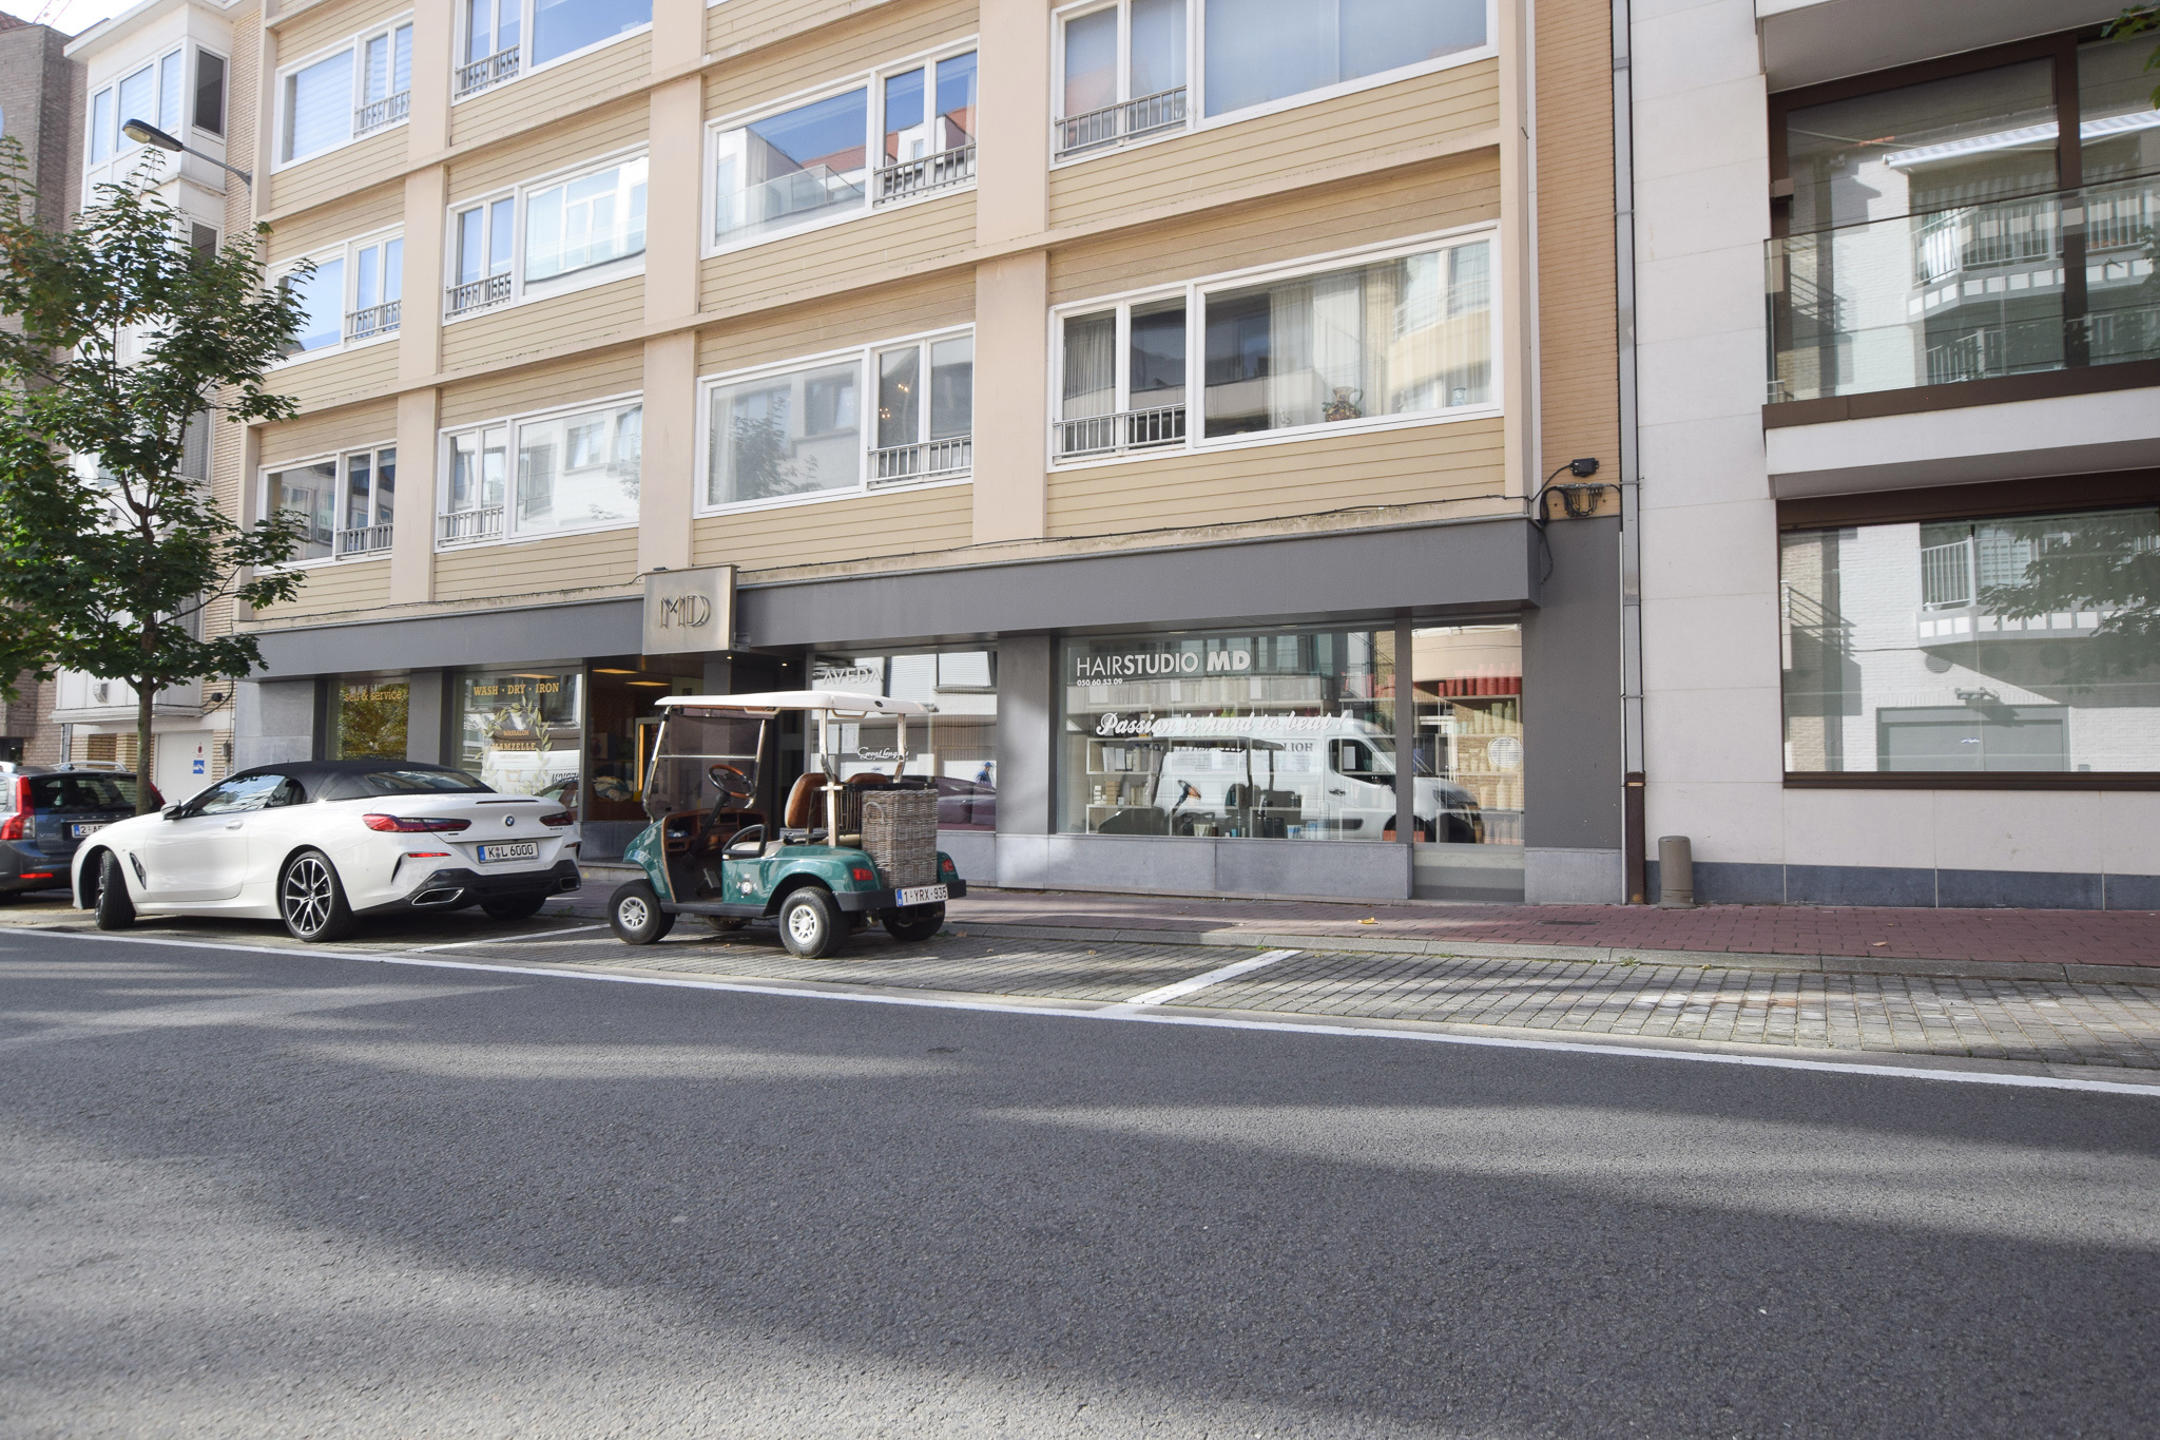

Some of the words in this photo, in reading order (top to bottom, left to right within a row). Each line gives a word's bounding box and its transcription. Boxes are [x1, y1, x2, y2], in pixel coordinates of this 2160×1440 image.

[660, 592, 711, 629] MD
[1076, 651, 1199, 677] HAIRSTUDIO
[1206, 650, 1251, 672] MD
[823, 666, 884, 685] AVEDA
[473, 685, 498, 696] WASH
[507, 683, 526, 695] DRY
[535, 682, 559, 693] IRON
[1096, 711, 1176, 736] Passion
[1202, 710, 1255, 732] hard
[1259, 712, 1281, 730] to
[488, 848, 495, 858] K
[501, 847, 508, 857] L
[510, 844, 534, 857] 6000
